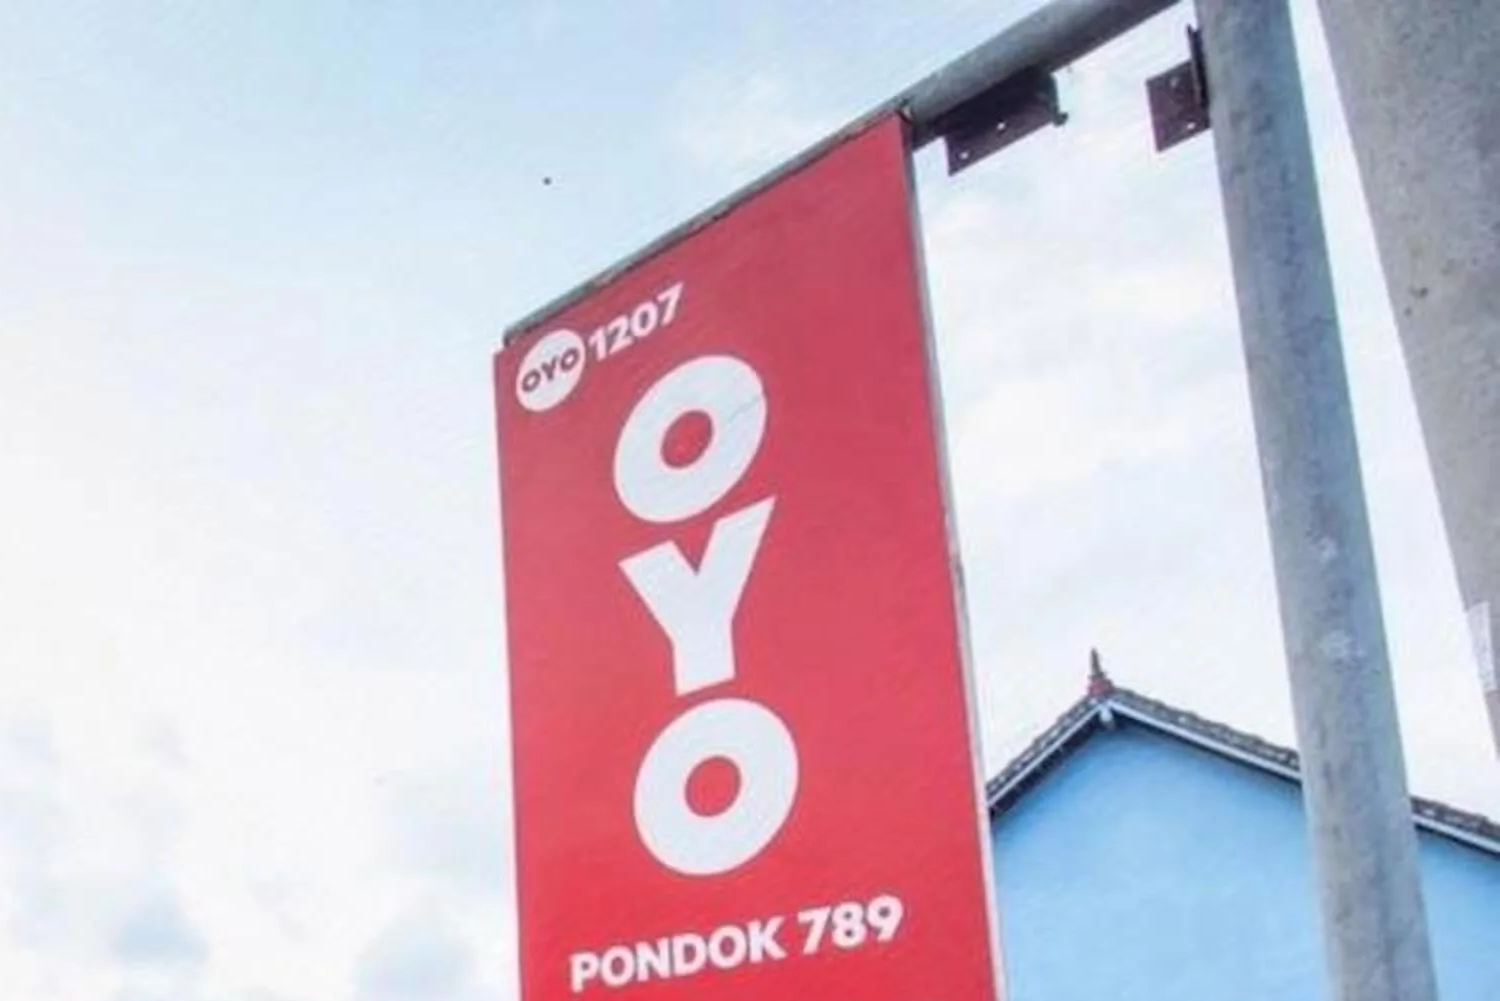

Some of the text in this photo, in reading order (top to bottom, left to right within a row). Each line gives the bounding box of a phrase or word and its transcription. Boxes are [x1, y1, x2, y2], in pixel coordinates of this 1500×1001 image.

[520, 282, 684, 392] OYO 1207
[612, 354, 800, 877] OYO
[569, 894, 904, 993] PONDOK 789
